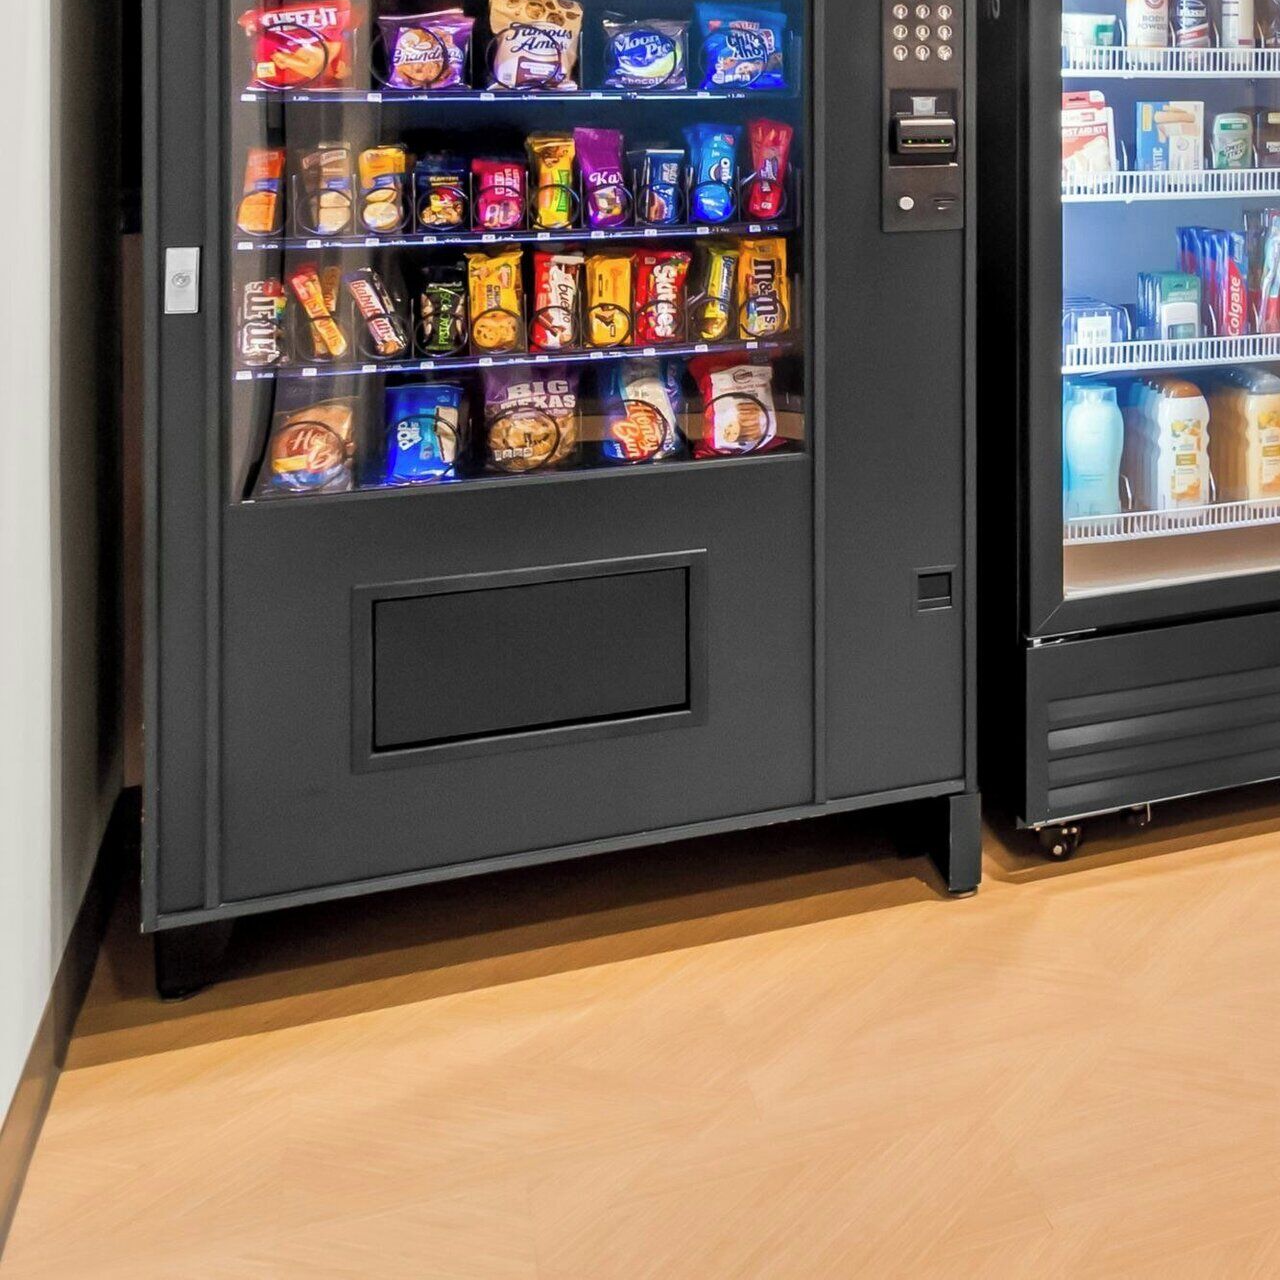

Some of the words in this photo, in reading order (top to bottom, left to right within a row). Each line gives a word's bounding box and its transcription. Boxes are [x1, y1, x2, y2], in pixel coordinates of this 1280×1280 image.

[506, 21, 574, 41] Famous
[1228, 276, 1242, 337] Colgate
[500, 394, 577, 410] TEXAS
[507, 380, 569, 401] BIG
[612, 419, 642, 458] Bun
[631, 402, 661, 452] Honey
